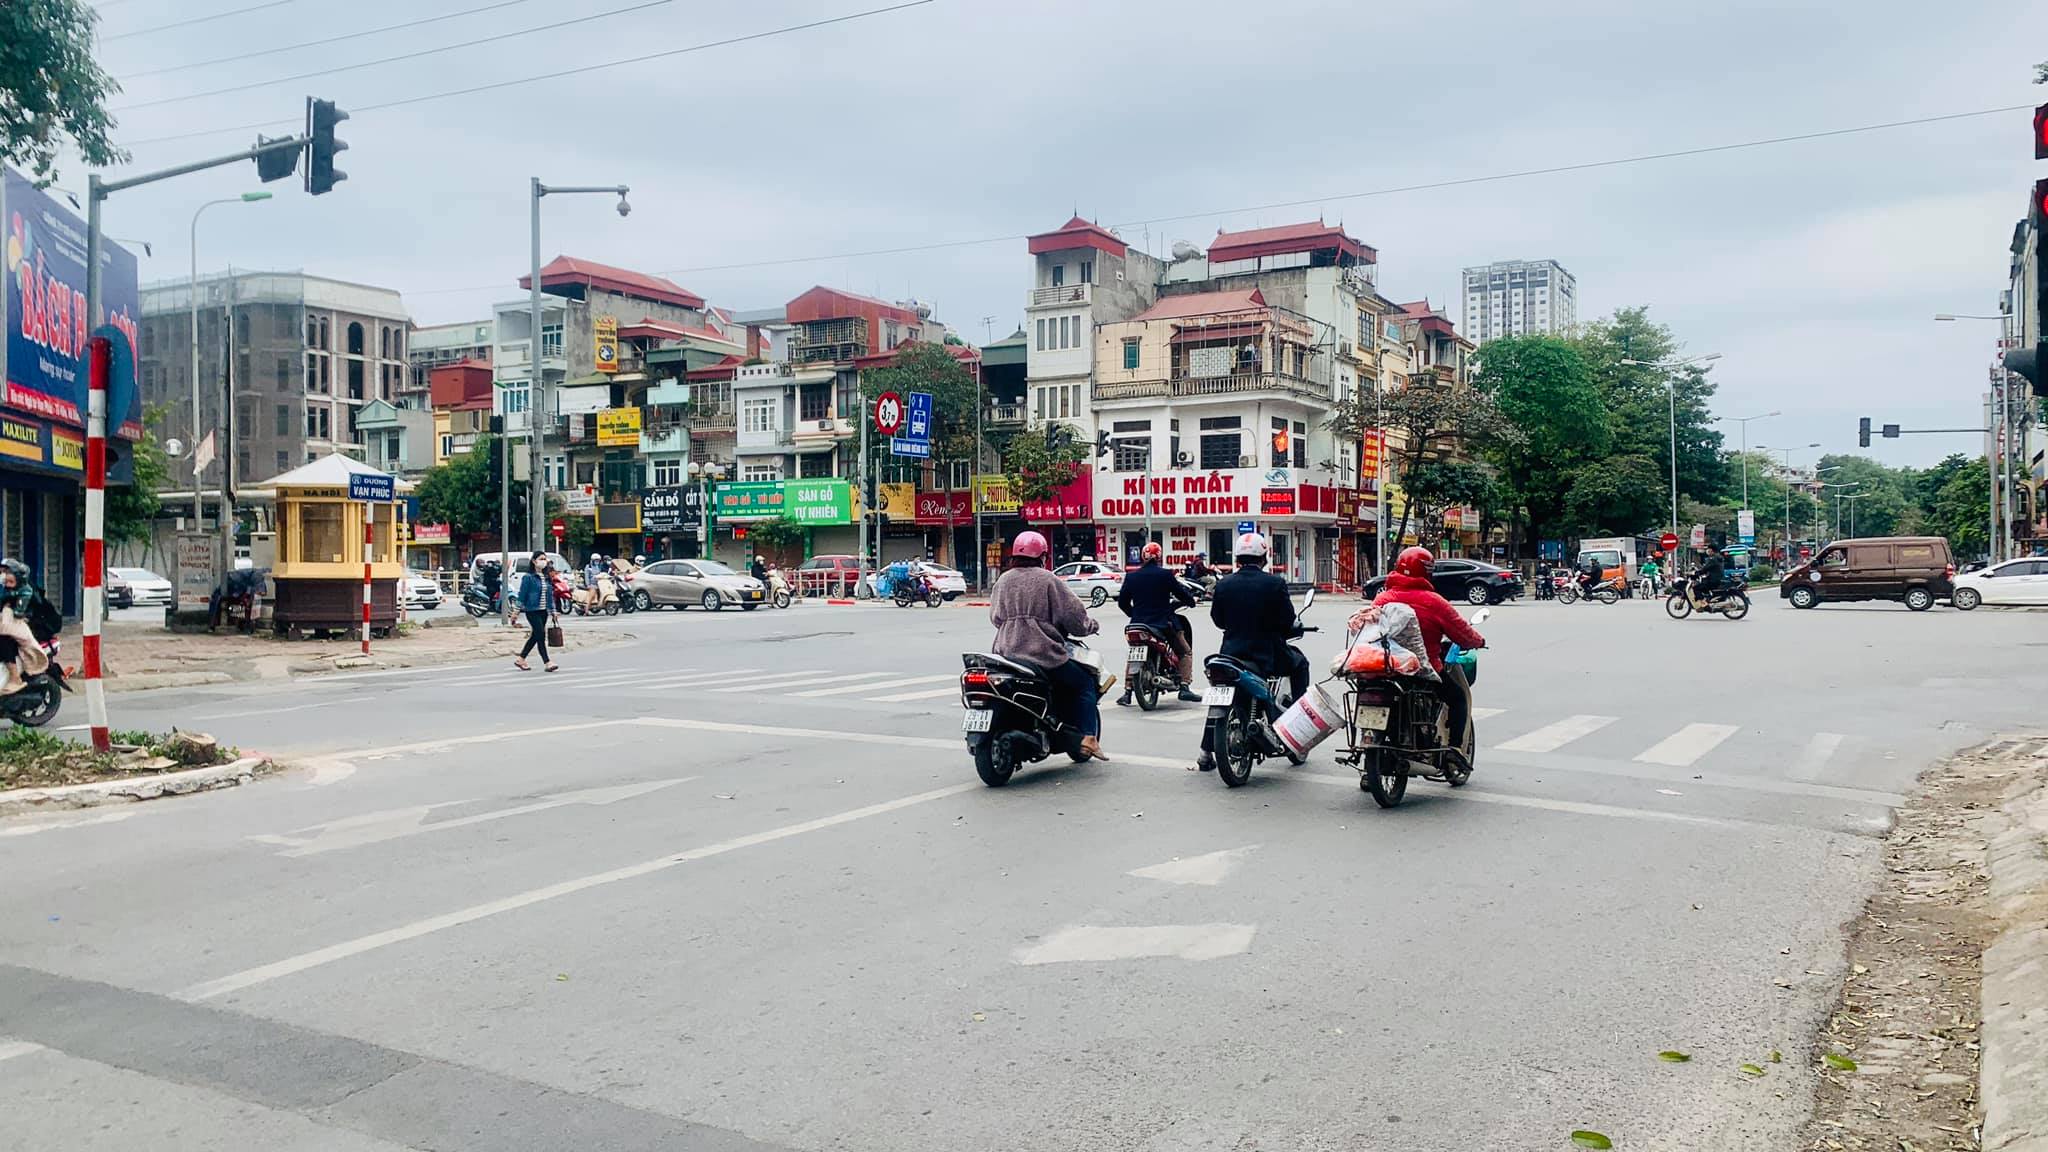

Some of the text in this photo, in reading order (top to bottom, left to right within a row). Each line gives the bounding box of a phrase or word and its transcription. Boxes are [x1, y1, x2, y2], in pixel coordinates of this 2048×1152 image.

[21, 247, 71, 358] BÁCH
[2, 421, 38, 443] MAXILITE
[353, 486, 390, 498] VẠN PHÚC
[820, 484, 833, 501] GỖ
[1123, 471, 1234, 495] KÍNH MẮT
[807, 503, 838, 519] NHIÊN
[1101, 498, 1176, 517] QUANG
[1184, 495, 1249, 515] MINH
